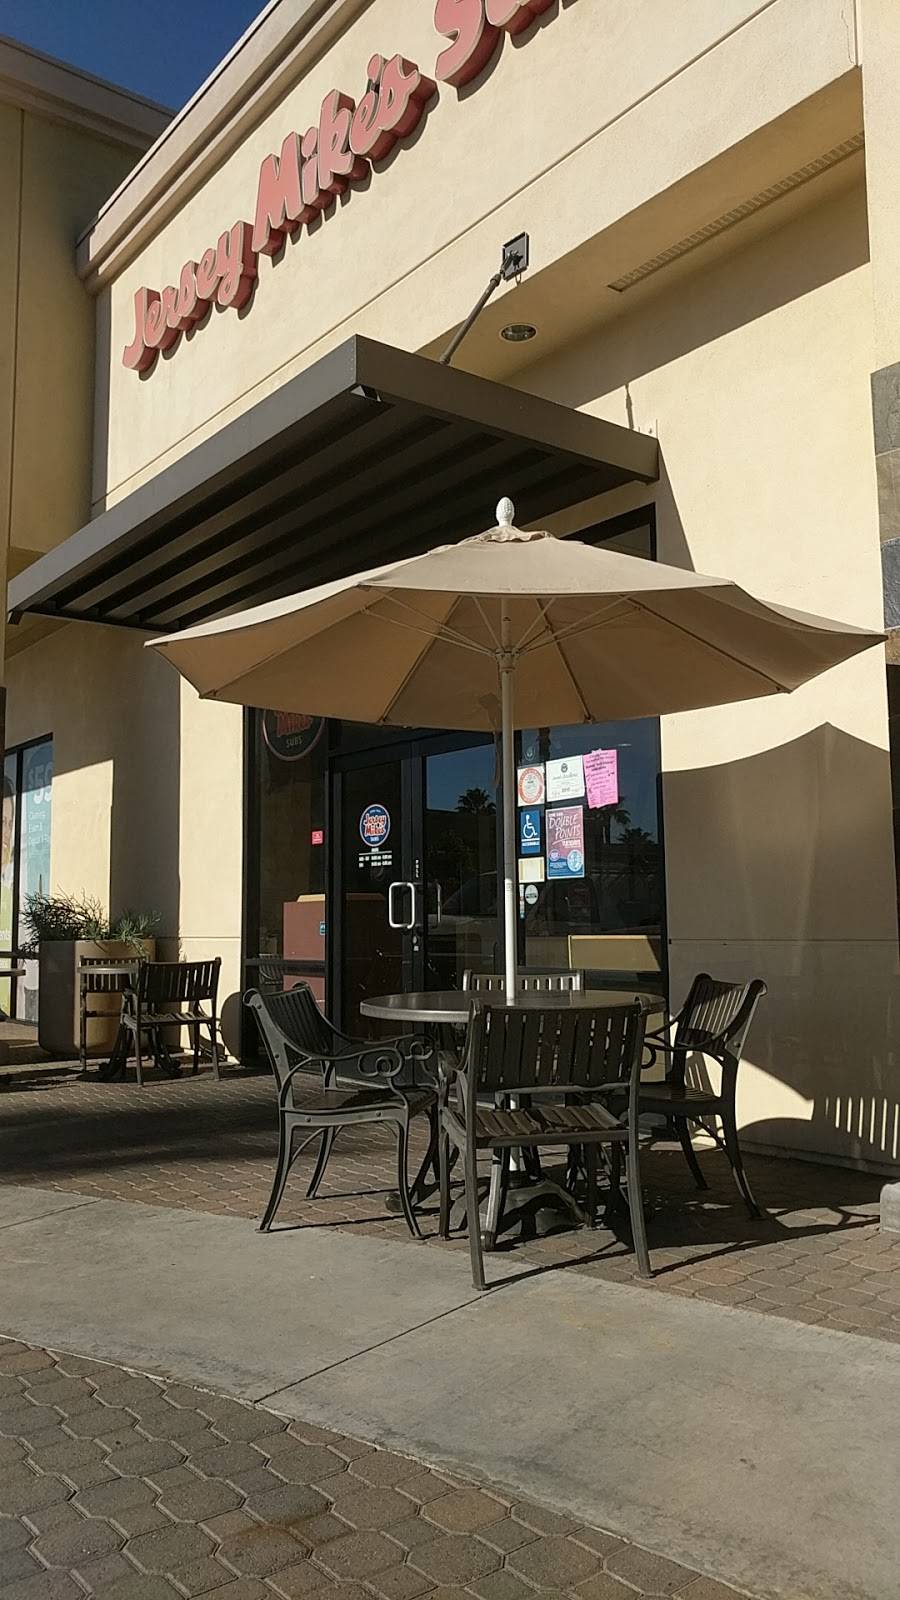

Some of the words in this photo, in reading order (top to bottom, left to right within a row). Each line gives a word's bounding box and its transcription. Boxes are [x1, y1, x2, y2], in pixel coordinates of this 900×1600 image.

[122, 220, 257, 374] Jersey
[252, 53, 433, 255] Mike's
[363, 812, 387, 826] Jersey
[549, 813, 578, 829] DOUBLE
[555, 824, 581, 840] POINTS
